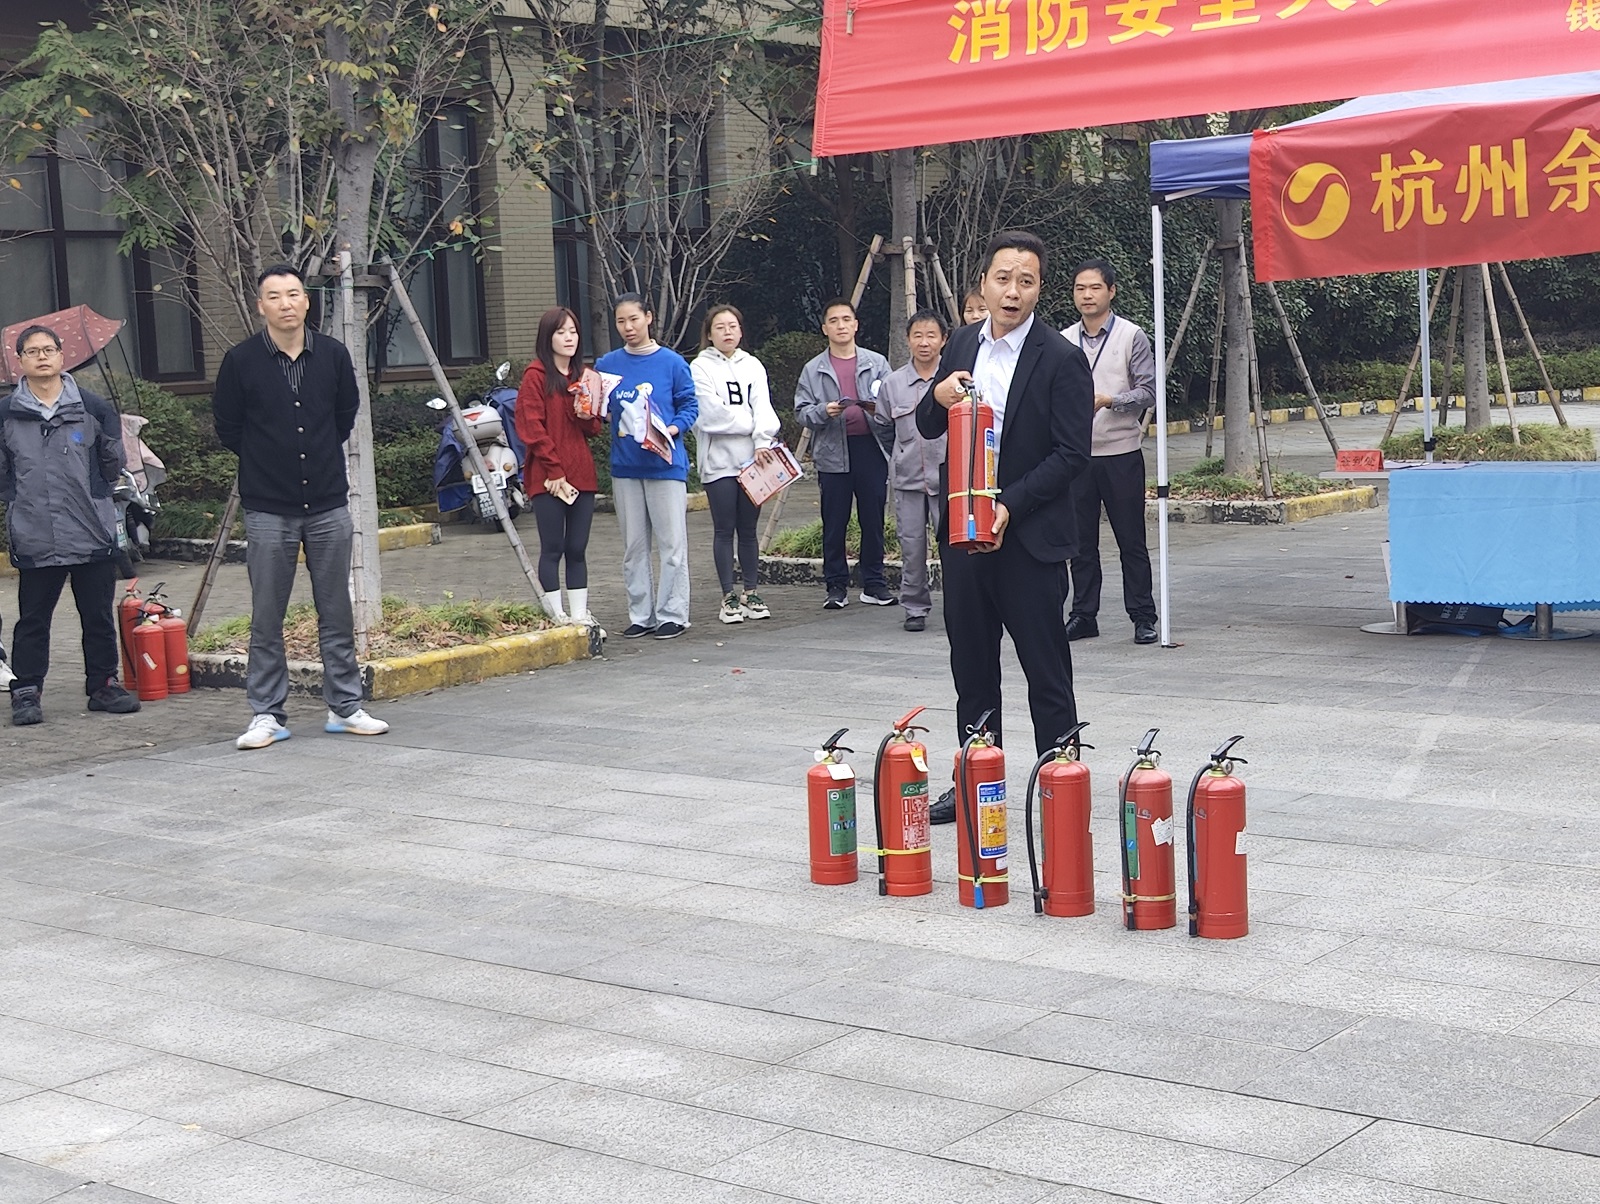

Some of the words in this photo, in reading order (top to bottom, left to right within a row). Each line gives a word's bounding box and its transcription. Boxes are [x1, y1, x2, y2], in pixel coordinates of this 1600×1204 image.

[947, 0, 1392, 64] 消防安
[1370, 127, 1600, 233] 杭州余
